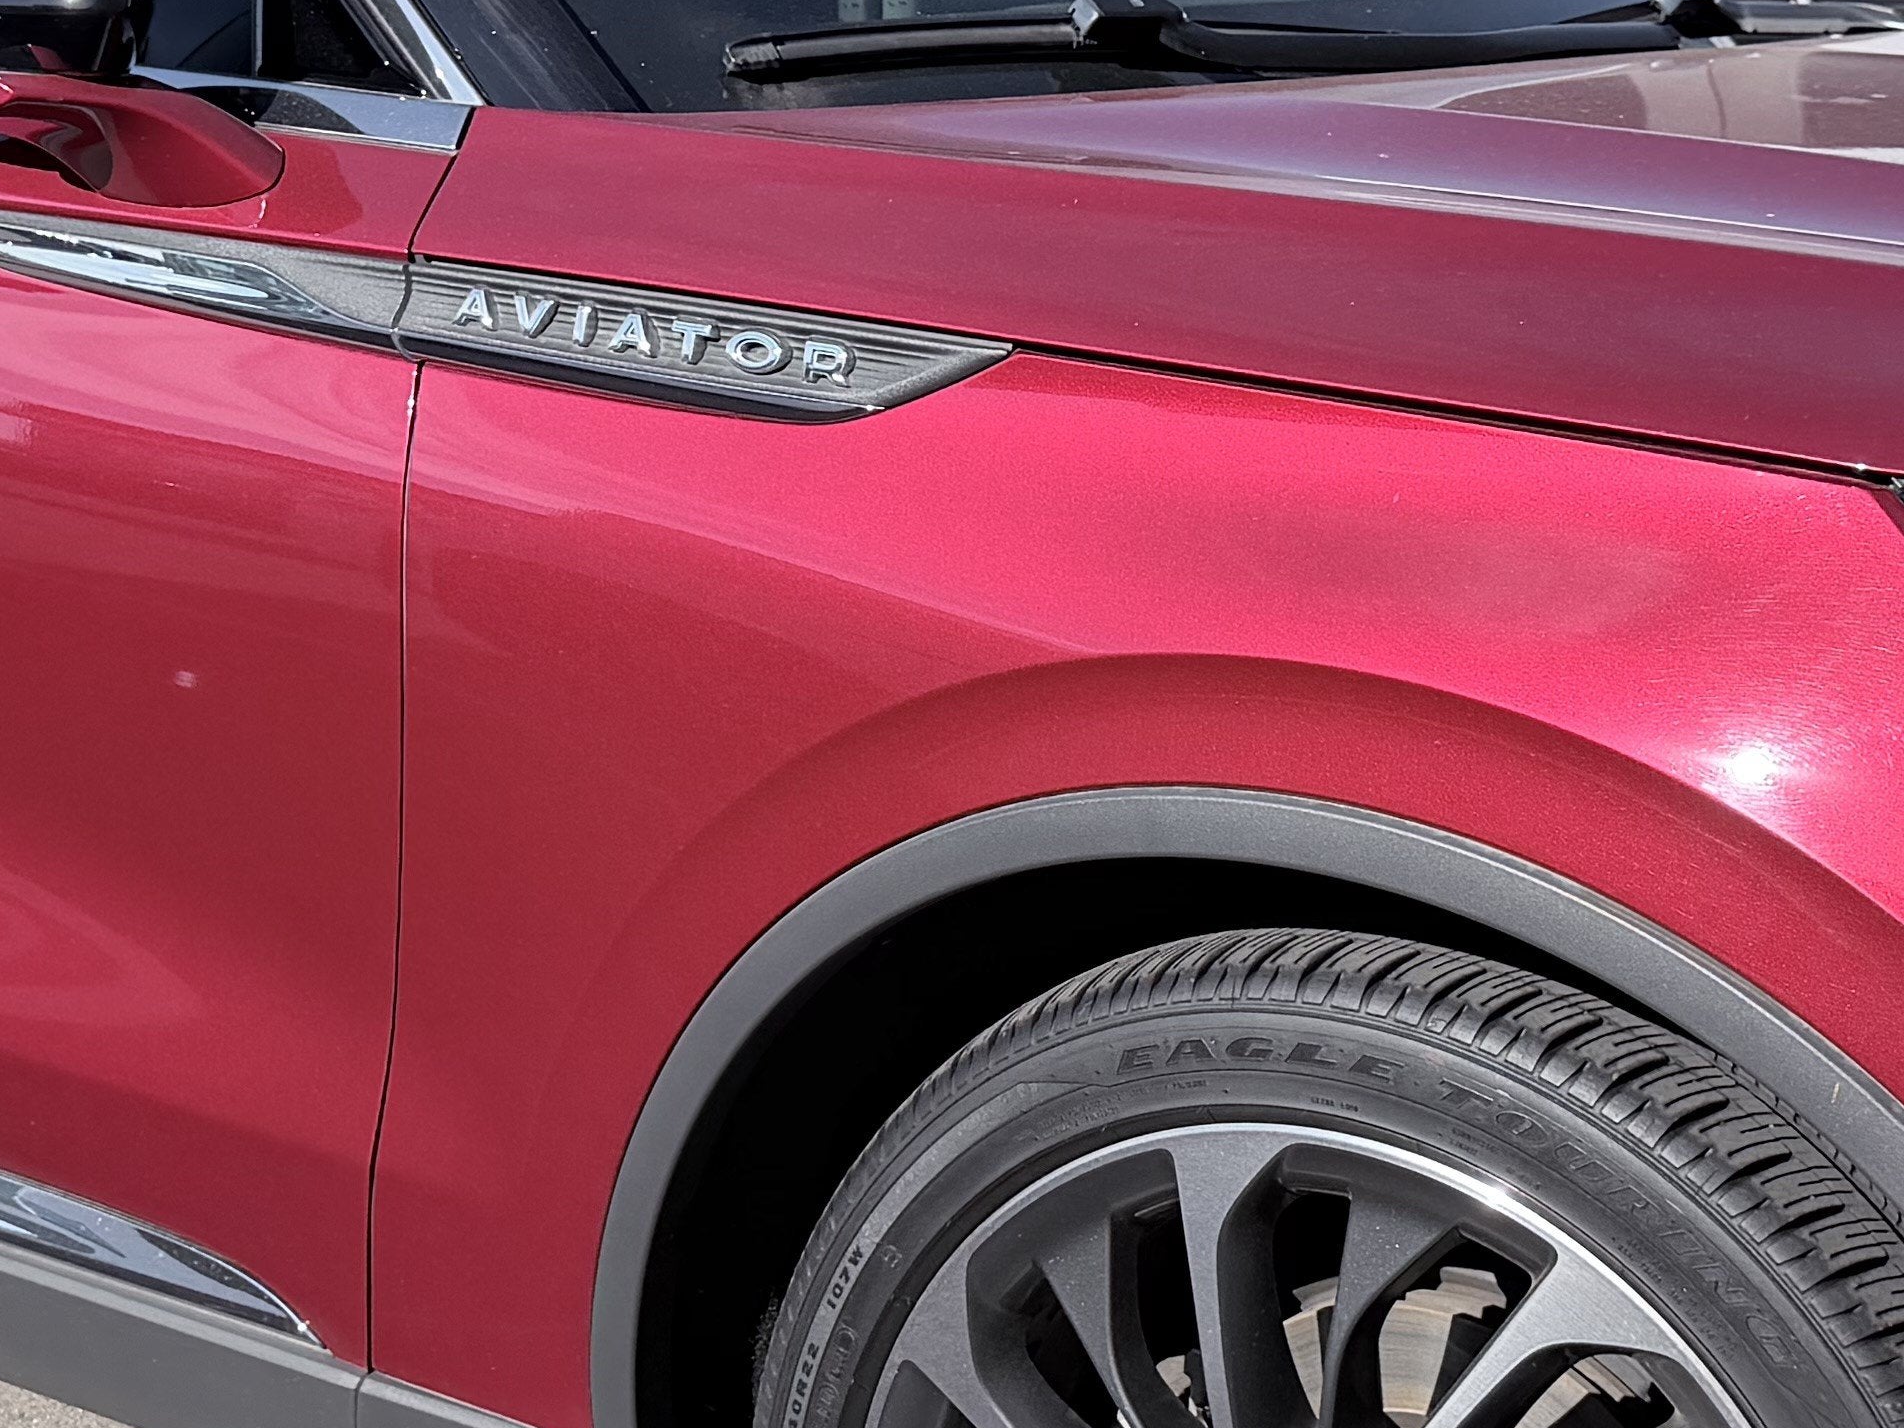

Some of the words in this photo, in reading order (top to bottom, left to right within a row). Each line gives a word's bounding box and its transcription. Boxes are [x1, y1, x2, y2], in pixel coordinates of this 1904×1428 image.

[451, 285, 856, 388] AVIATOR
[1116, 1036, 1405, 1085] EAGLE
[826, 1243, 863, 1310] 107W
